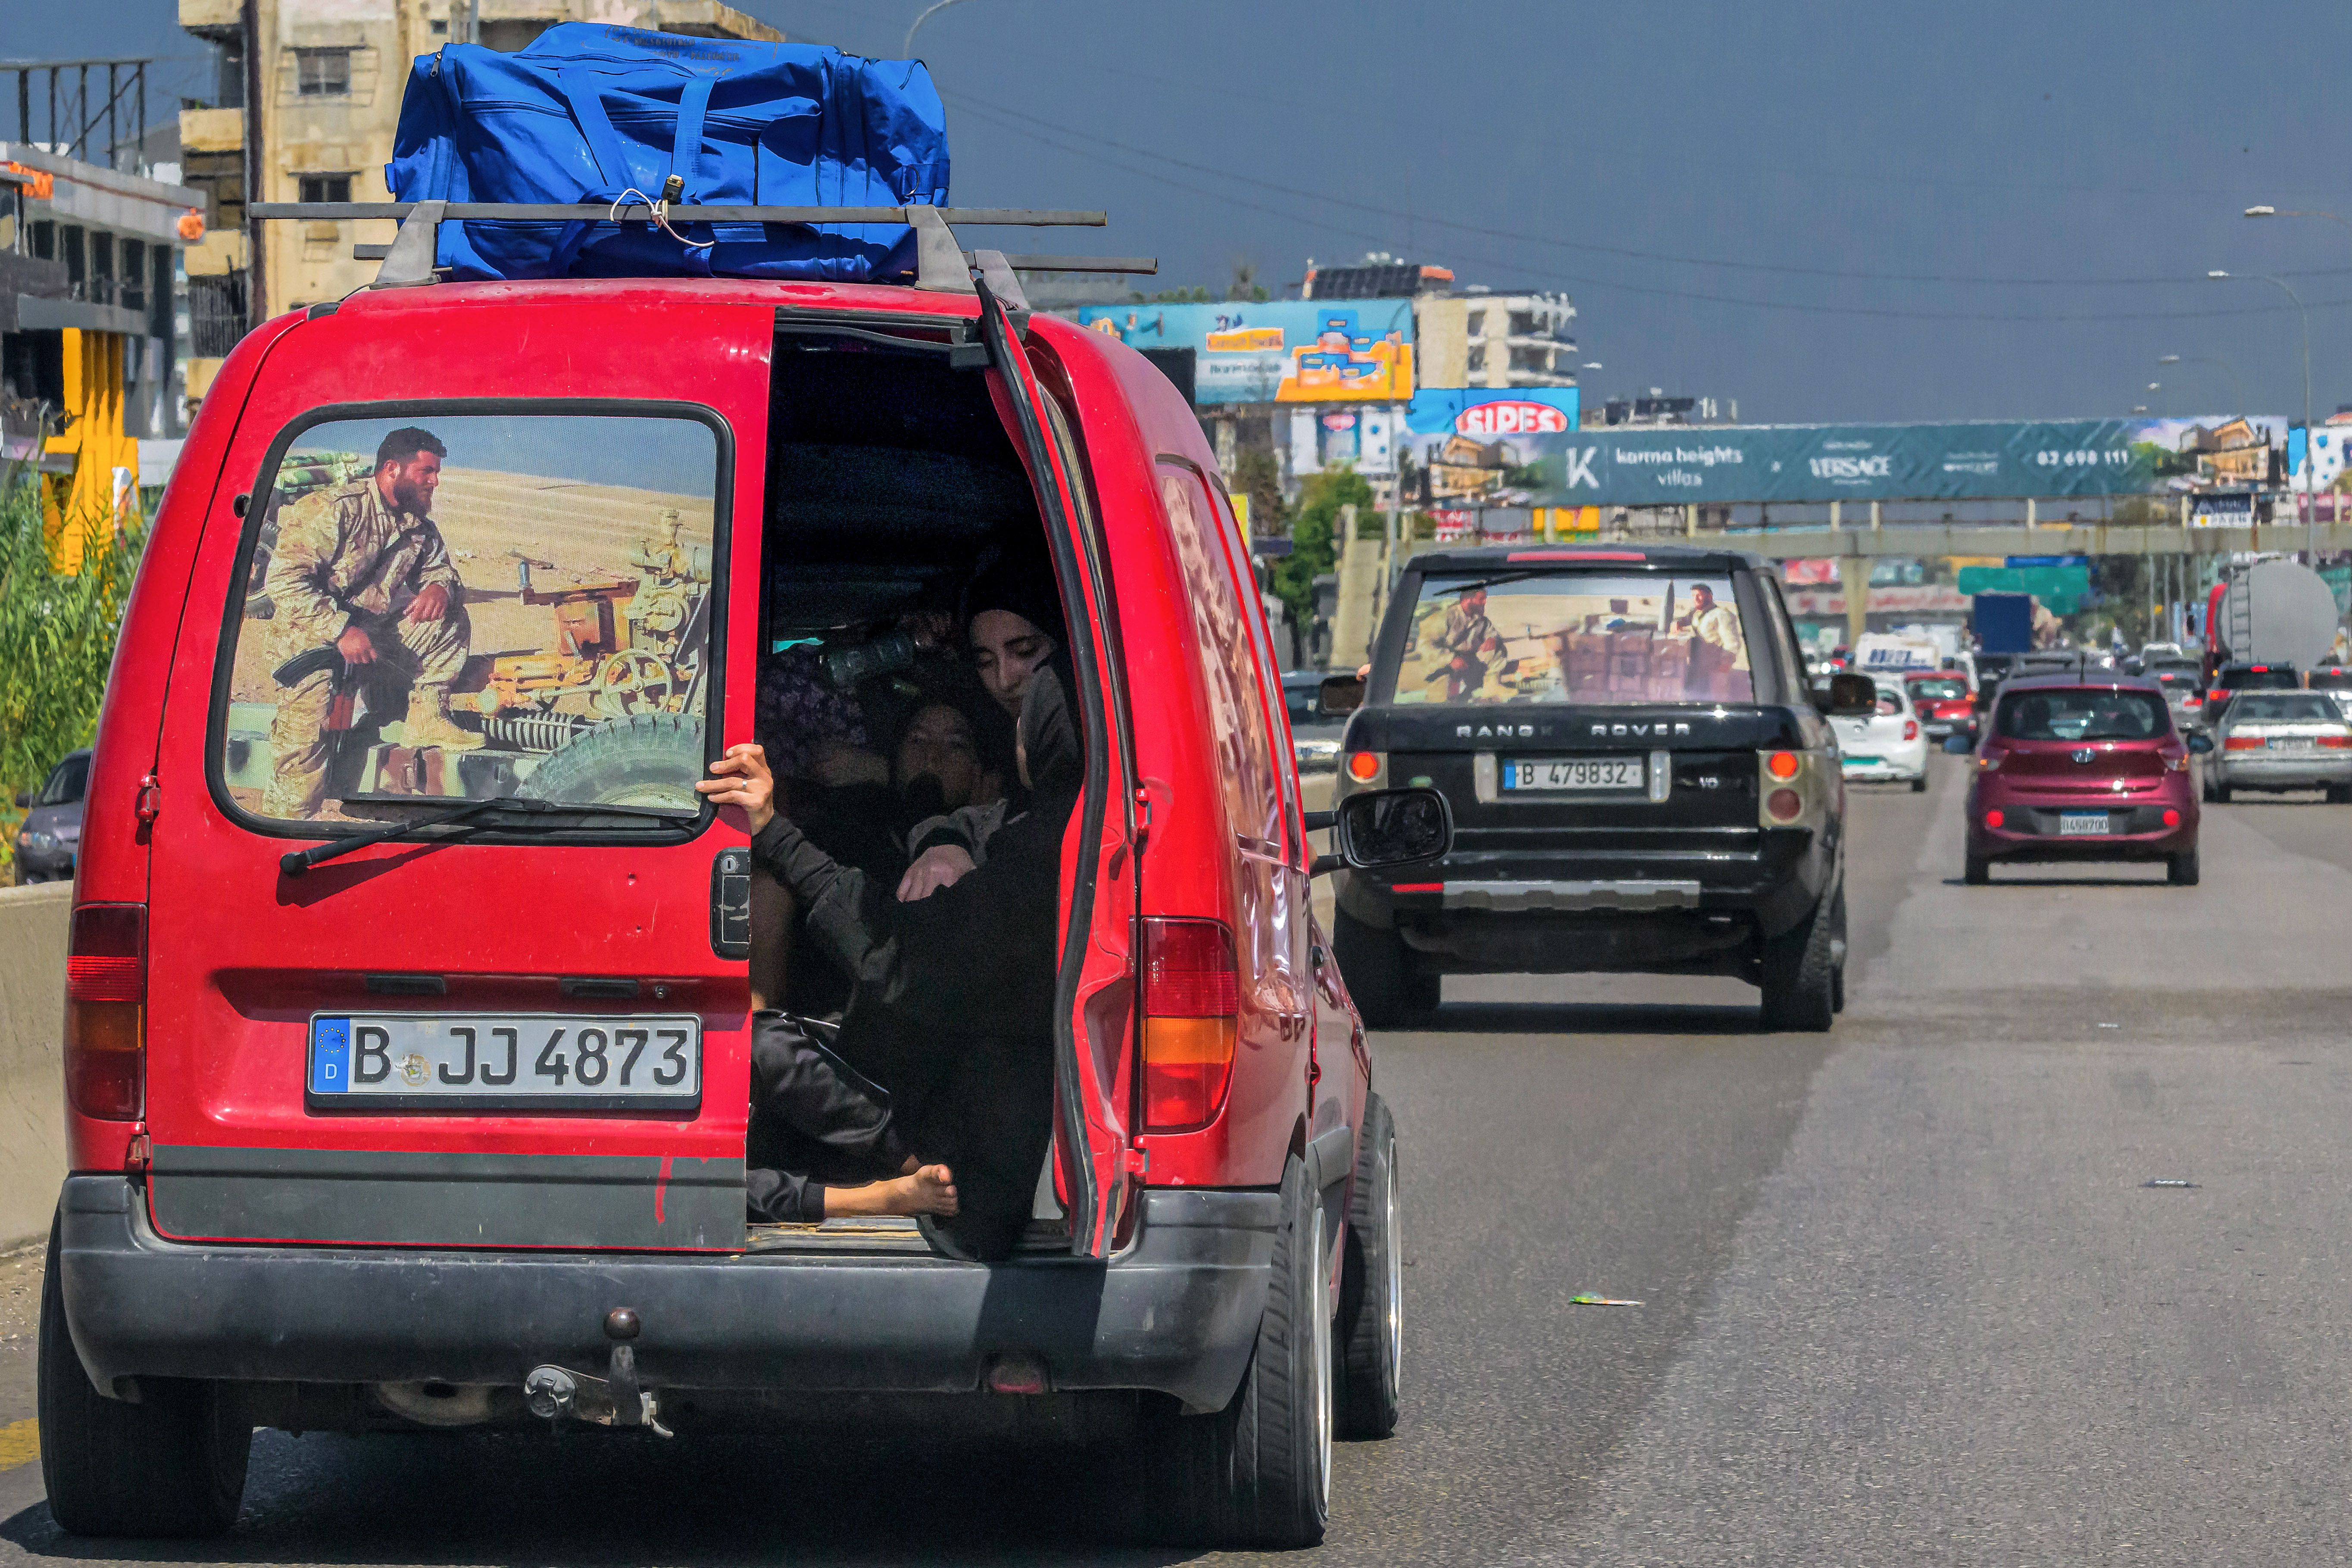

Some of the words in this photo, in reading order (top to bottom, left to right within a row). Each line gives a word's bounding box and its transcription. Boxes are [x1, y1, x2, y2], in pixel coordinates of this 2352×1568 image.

[1467, 406, 1556, 433] SIPES
[1676, 446, 1743, 467] heights
[1809, 456, 1892, 478] VERSACE
[1566, 447, 1599, 489] K
[1658, 469, 1702, 487] villas
[1456, 724, 1552, 737] RANG
[1591, 723, 1690, 736] ROVER
[1522, 763, 1534, 785] B
[1549, 762, 1628, 785] 479832
[354, 1026, 391, 1085] B
[438, 1027, 517, 1086] JJ
[534, 1028, 688, 1087] 4873
[325, 1063, 337, 1079] D
